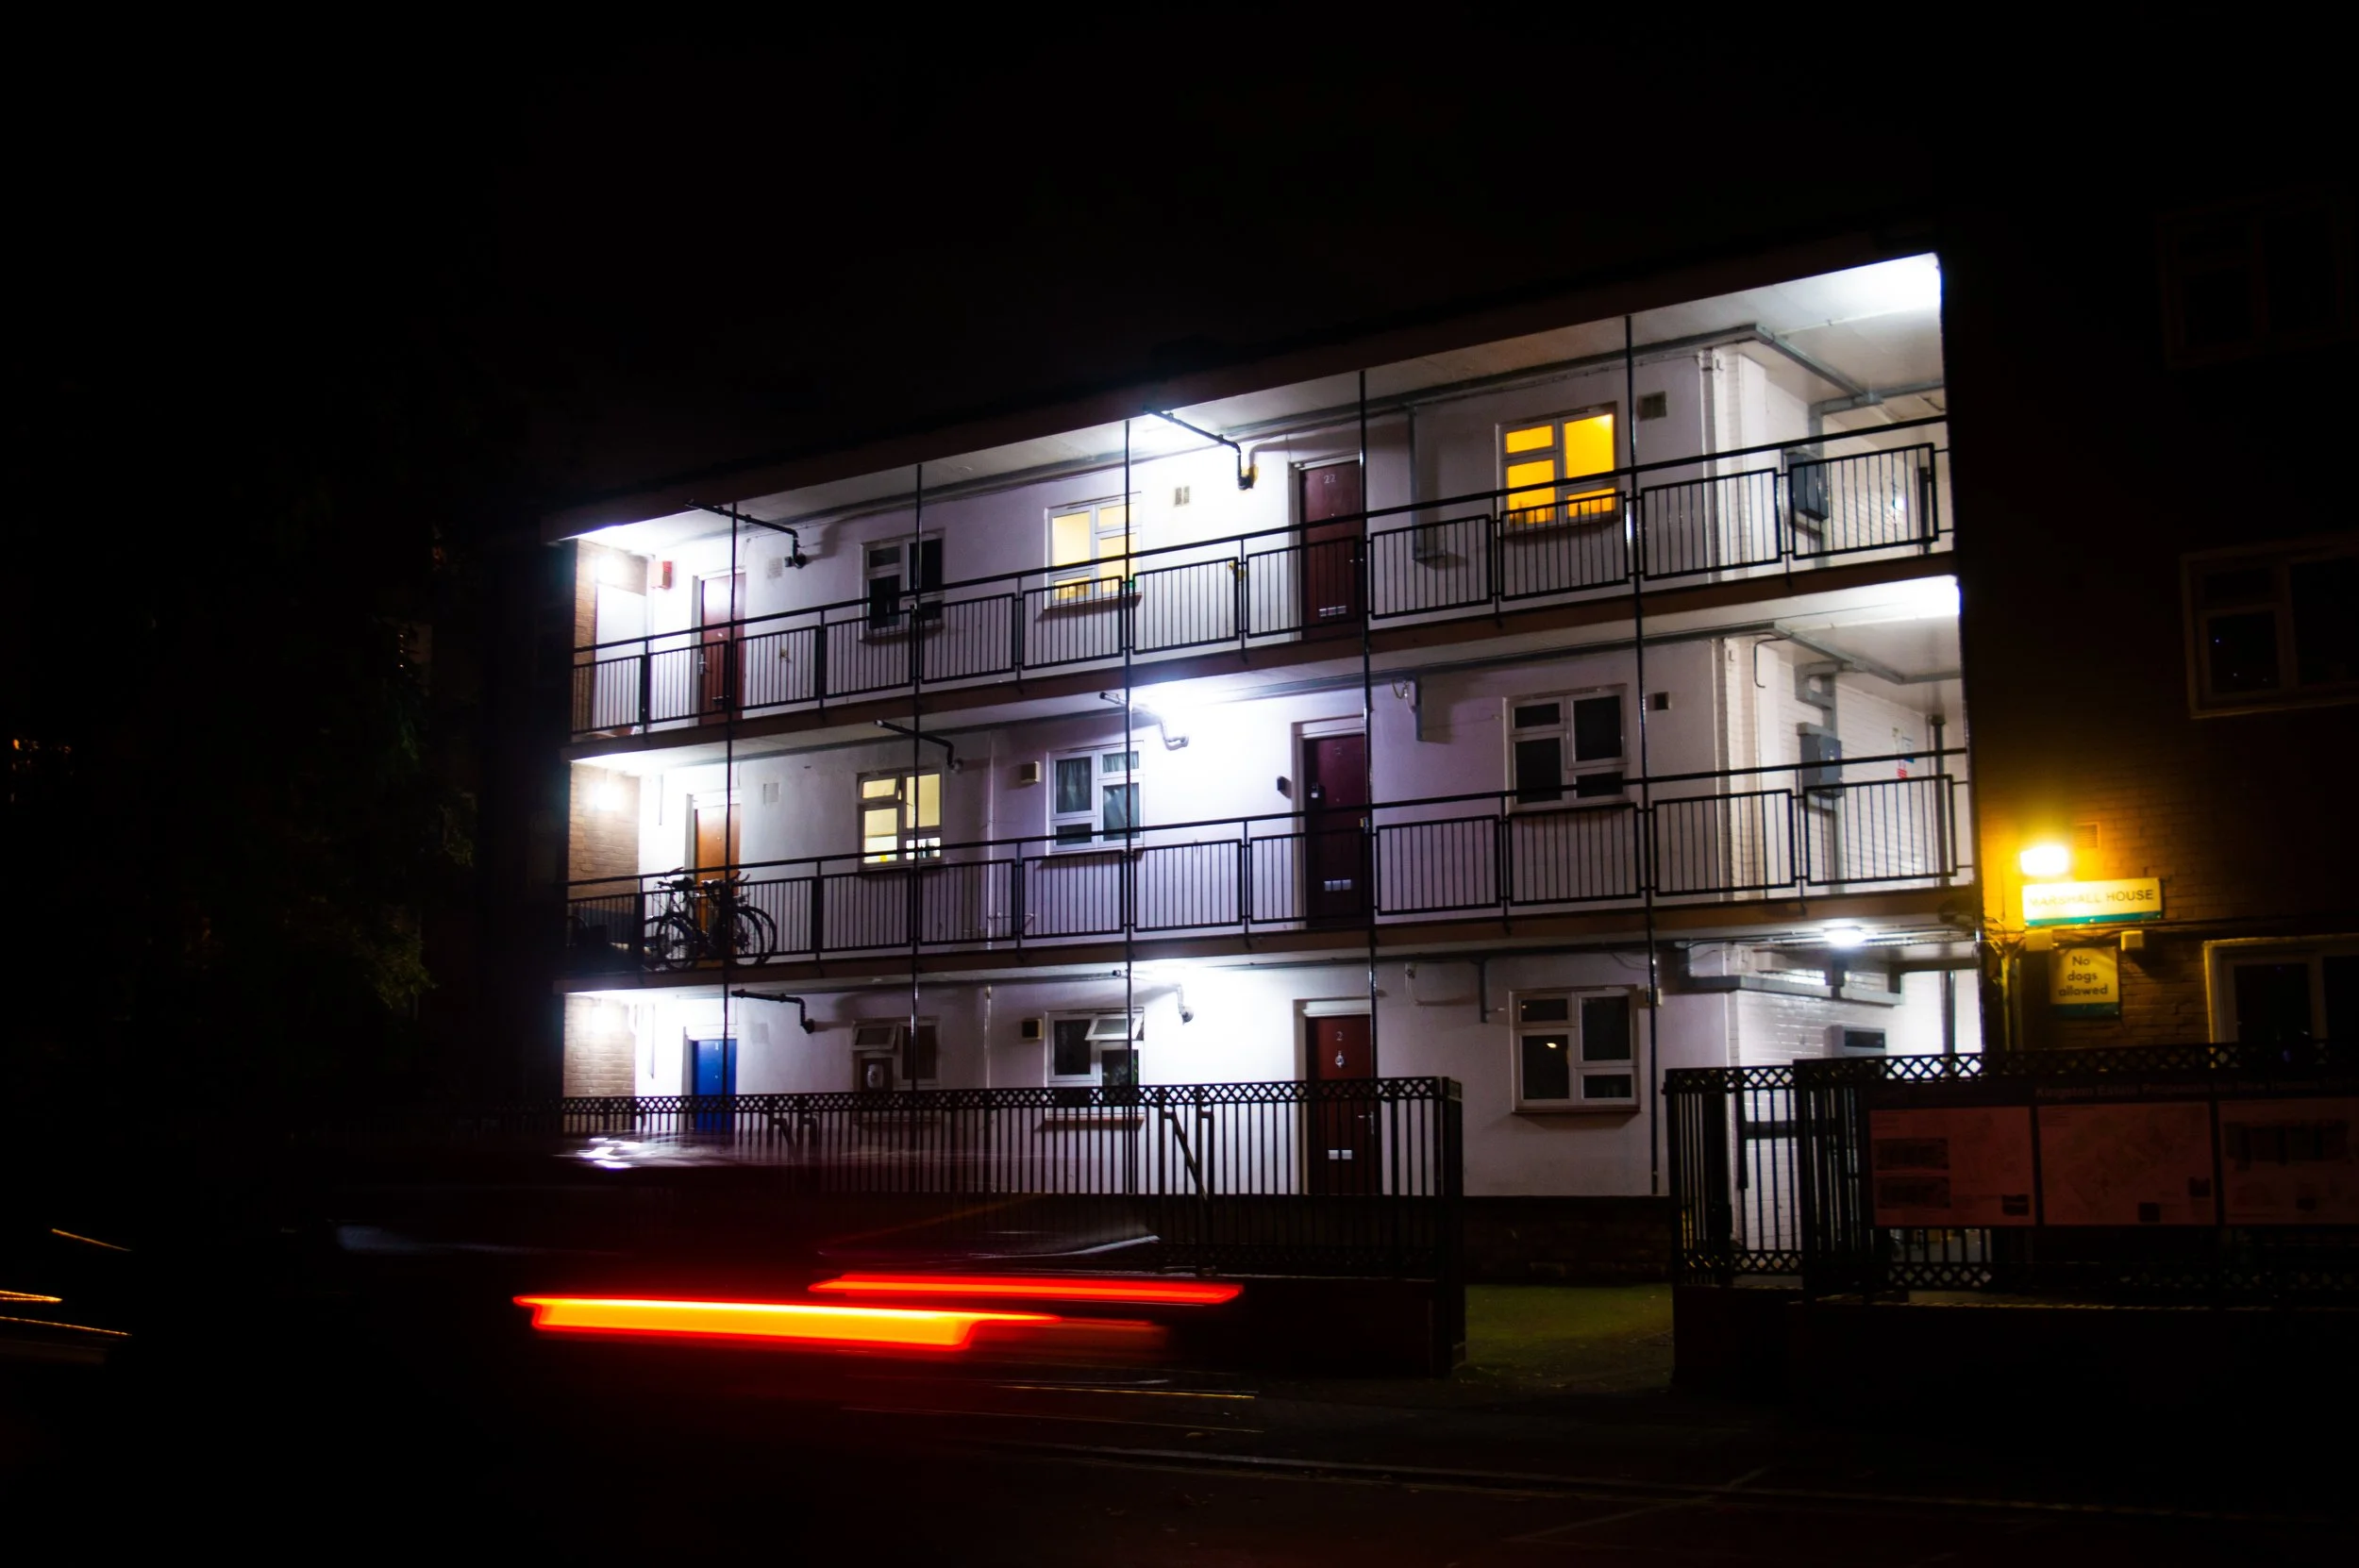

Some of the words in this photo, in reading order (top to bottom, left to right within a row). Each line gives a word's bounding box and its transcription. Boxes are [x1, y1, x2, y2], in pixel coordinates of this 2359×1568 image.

[2029, 893, 2101, 906] MARSHALL
[2106, 889, 2154, 902] HOUSE
[2072, 956, 2090, 966] No
[2067, 970, 2099, 984] dogs
[2059, 983, 2108, 996] allowed
[1336, 1031, 1344, 1042] 2
